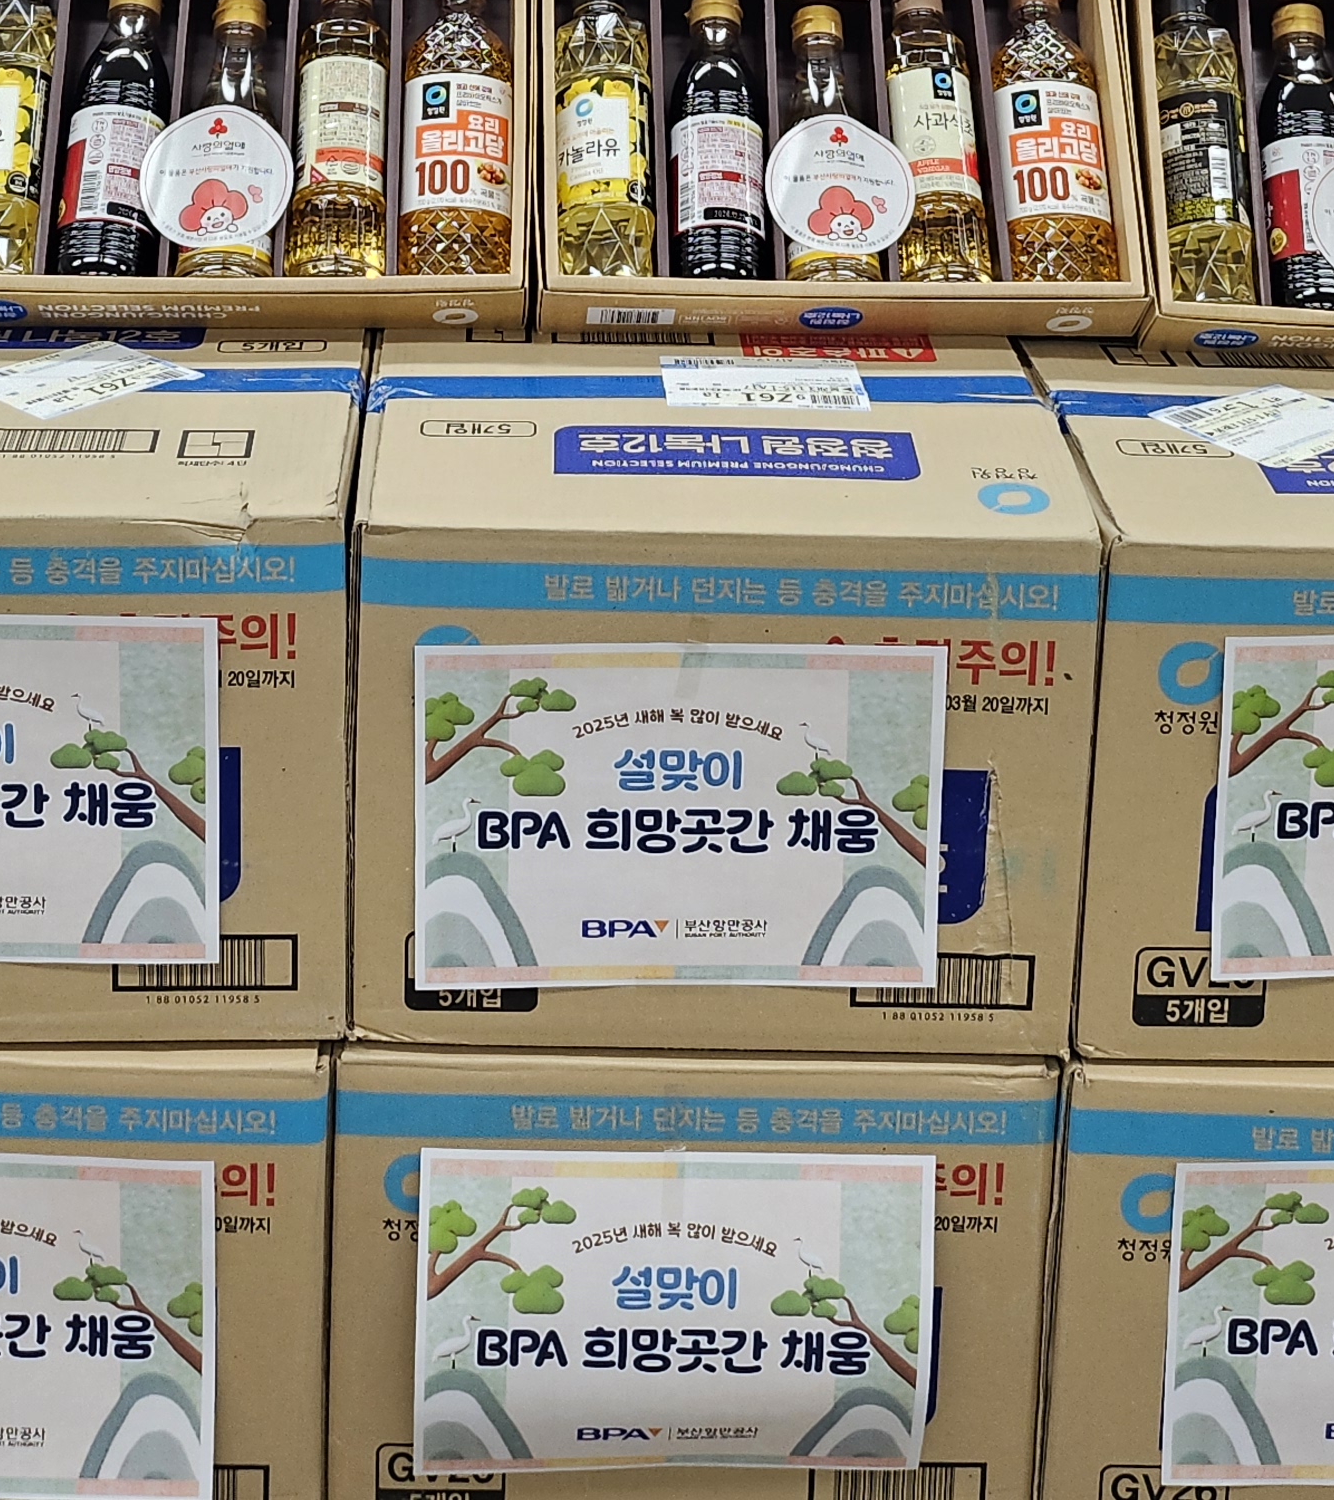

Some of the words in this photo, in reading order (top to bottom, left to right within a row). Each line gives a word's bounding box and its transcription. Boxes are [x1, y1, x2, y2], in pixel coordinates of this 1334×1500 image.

[468, 114, 499, 134] 요리
[421, 130, 504, 159] 올리고당
[558, 138, 620, 167] 카놀라유
[415, 159, 470, 196] 100
[11, 558, 35, 586] 등
[45, 558, 125, 588] 충격을
[133, 557, 297, 587] 주지마십시오!
[226, 667, 297, 691] 20일까지
[613, 748, 745, 794] 설맞이
[62, 782, 158, 830] 채움
[156, 995, 169, 1004] 88
[175, 995, 209, 1004] 01052
[215, 995, 249, 1003] 11958
[611, 1263, 739, 1311] 설맞이
